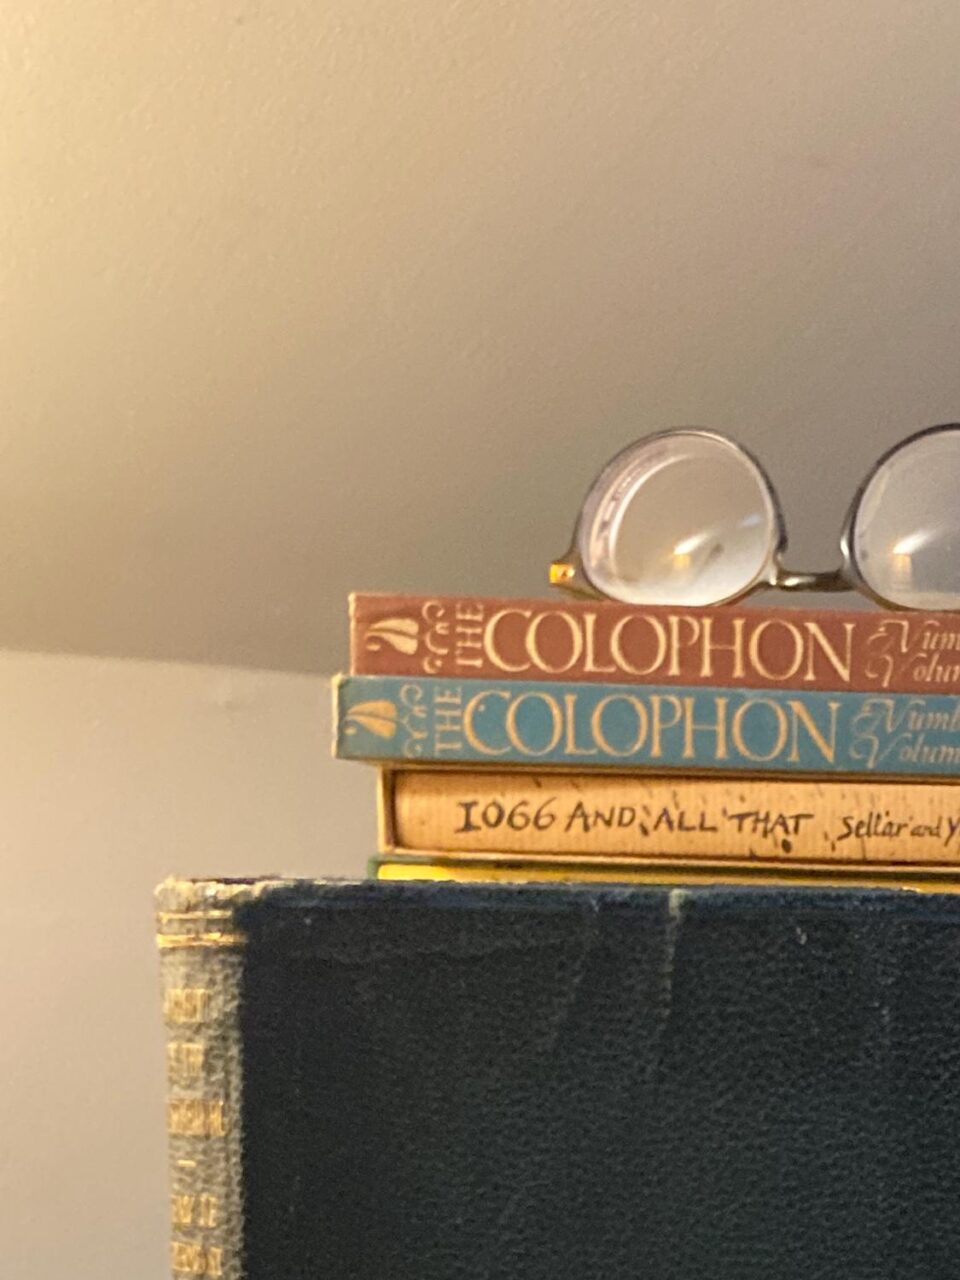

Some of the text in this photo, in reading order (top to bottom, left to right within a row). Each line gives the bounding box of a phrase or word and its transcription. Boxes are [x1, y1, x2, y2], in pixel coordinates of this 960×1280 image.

[455, 603, 484, 668] THE
[483, 606, 854, 684] COLOPHON
[434, 685, 464, 755] THE
[463, 688, 841, 764] COLOPHON
[565, 801, 636, 833] AND
[653, 806, 718, 834] ALL
[727, 810, 815, 839] THAT
[837, 809, 908, 841] Sellar
[910, 816, 942, 839] and
